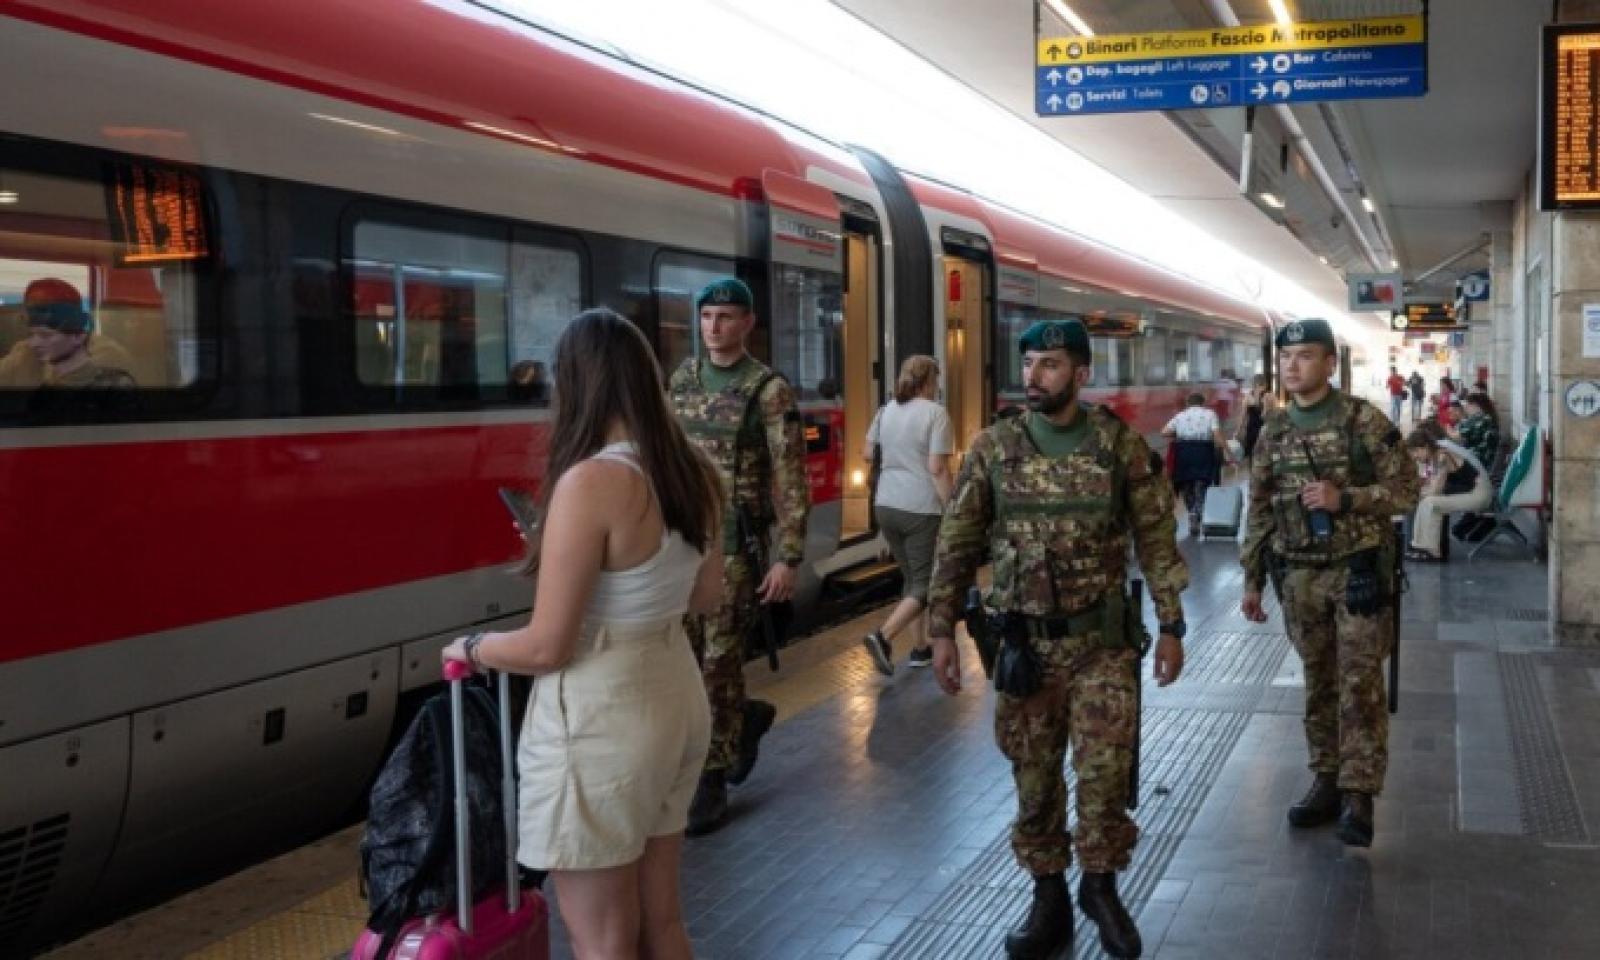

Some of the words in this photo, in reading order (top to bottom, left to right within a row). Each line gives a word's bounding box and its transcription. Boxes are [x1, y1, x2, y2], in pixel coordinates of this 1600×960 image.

[1086, 37, 1137, 55] Binari
[1142, 34, 1207, 51] Platforms
[1211, 29, 1265, 47] Fascio
[1293, 53, 1316, 65] Bar
[1117, 61, 1163, 75] bagagli
[1086, 89, 1127, 102] Servizi
